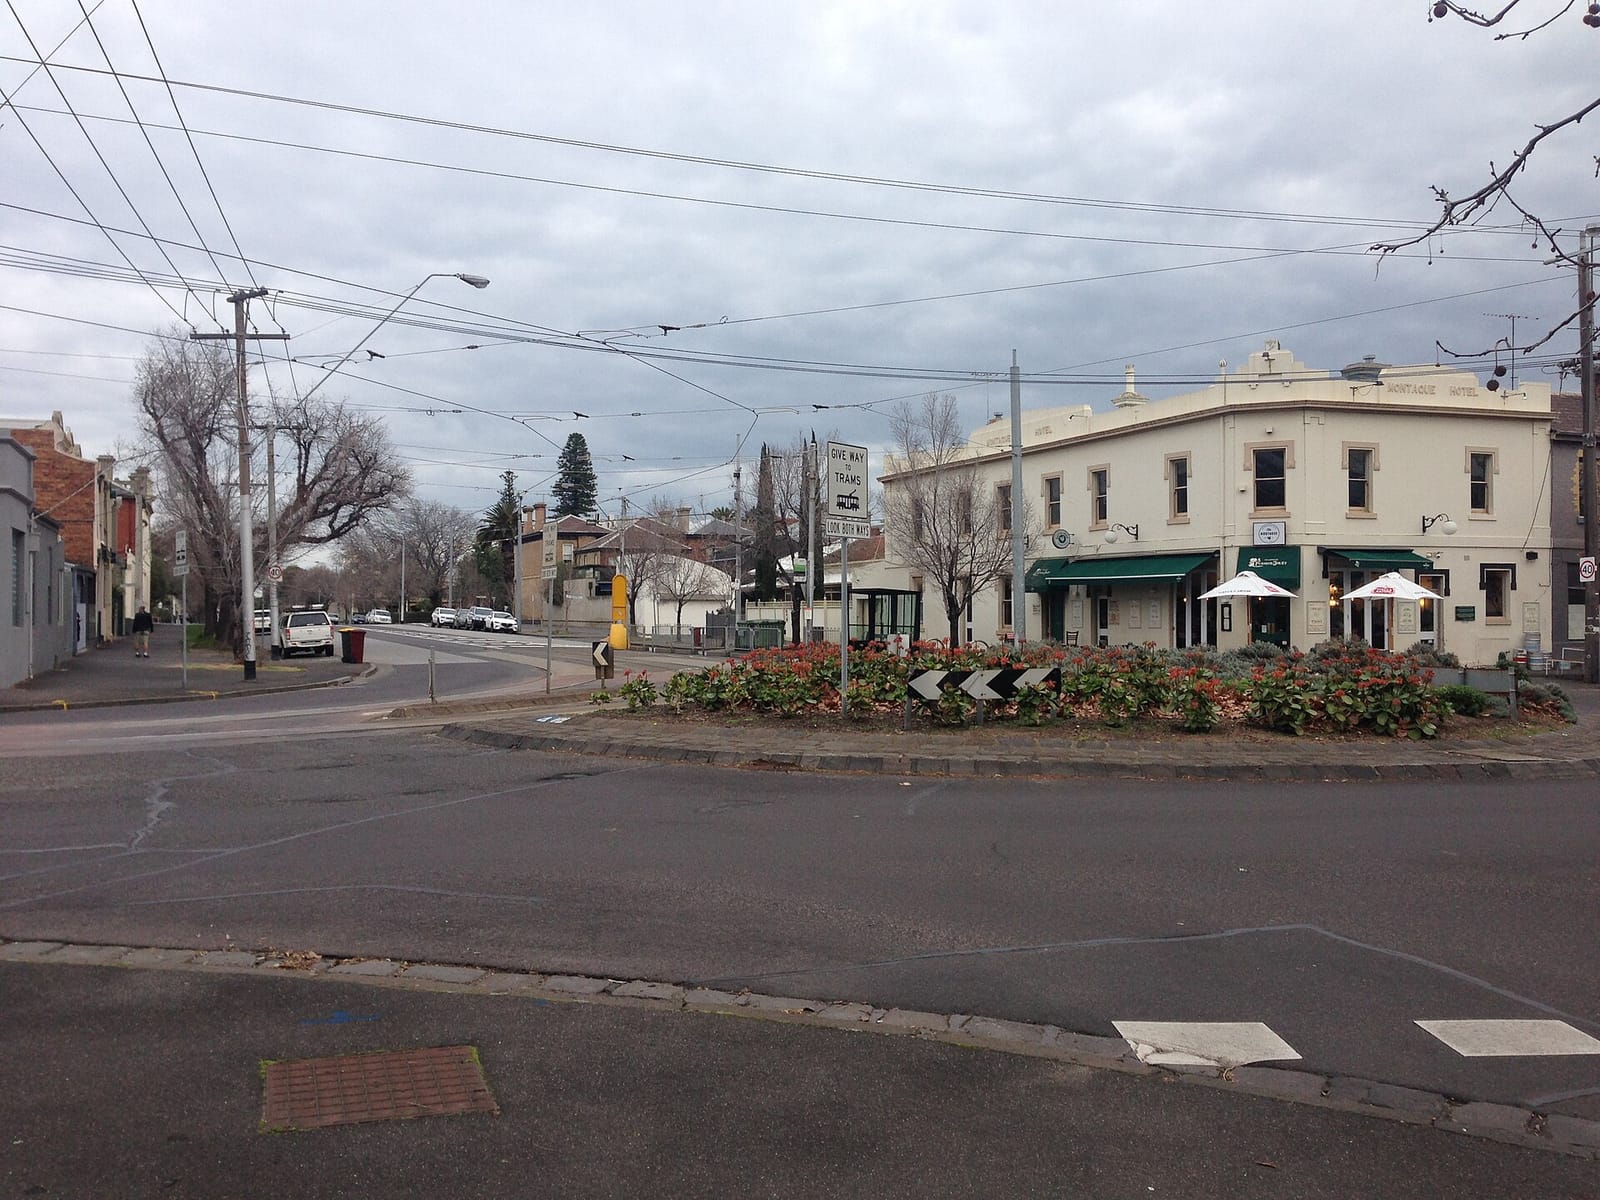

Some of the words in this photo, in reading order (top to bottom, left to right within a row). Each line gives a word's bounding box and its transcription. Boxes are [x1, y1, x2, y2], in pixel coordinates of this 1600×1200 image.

[1449, 386, 1479, 397] HOTEL
[831, 448, 846, 461] GIVE
[849, 451, 865, 463] WAY
[834, 472, 861, 486] TRAMS
[827, 521, 839, 534] LOOK
[842, 522, 854, 535] BOTH
[857, 524, 869, 537] WAYS
[271, 569, 279, 577] 40
[1583, 565, 1592, 574] 40
